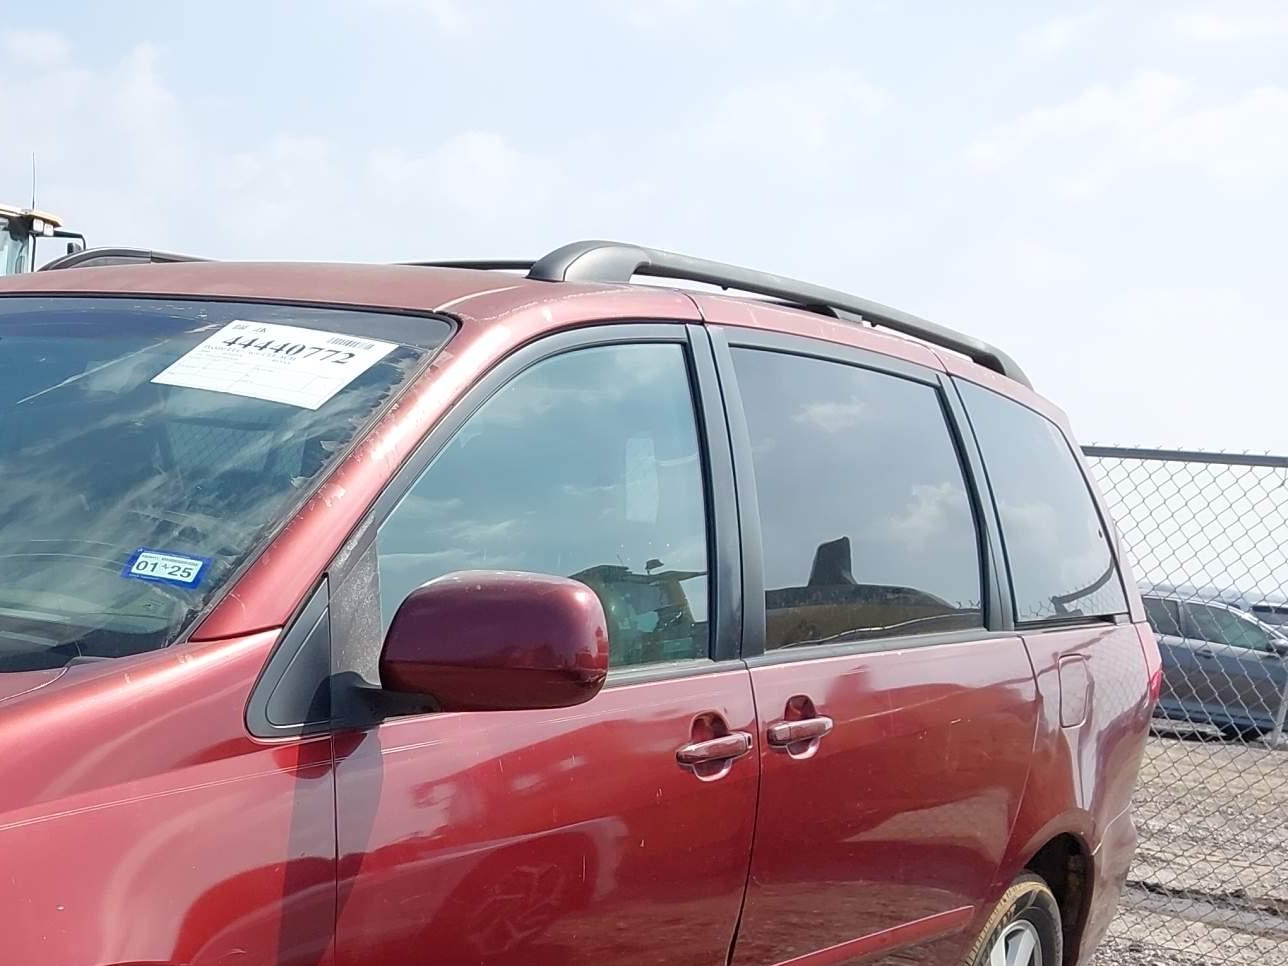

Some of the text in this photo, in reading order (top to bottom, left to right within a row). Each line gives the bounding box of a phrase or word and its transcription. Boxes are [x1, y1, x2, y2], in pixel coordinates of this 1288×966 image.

[223, 335, 356, 365] 44440772
[135, 560, 193, 578] 01 25
